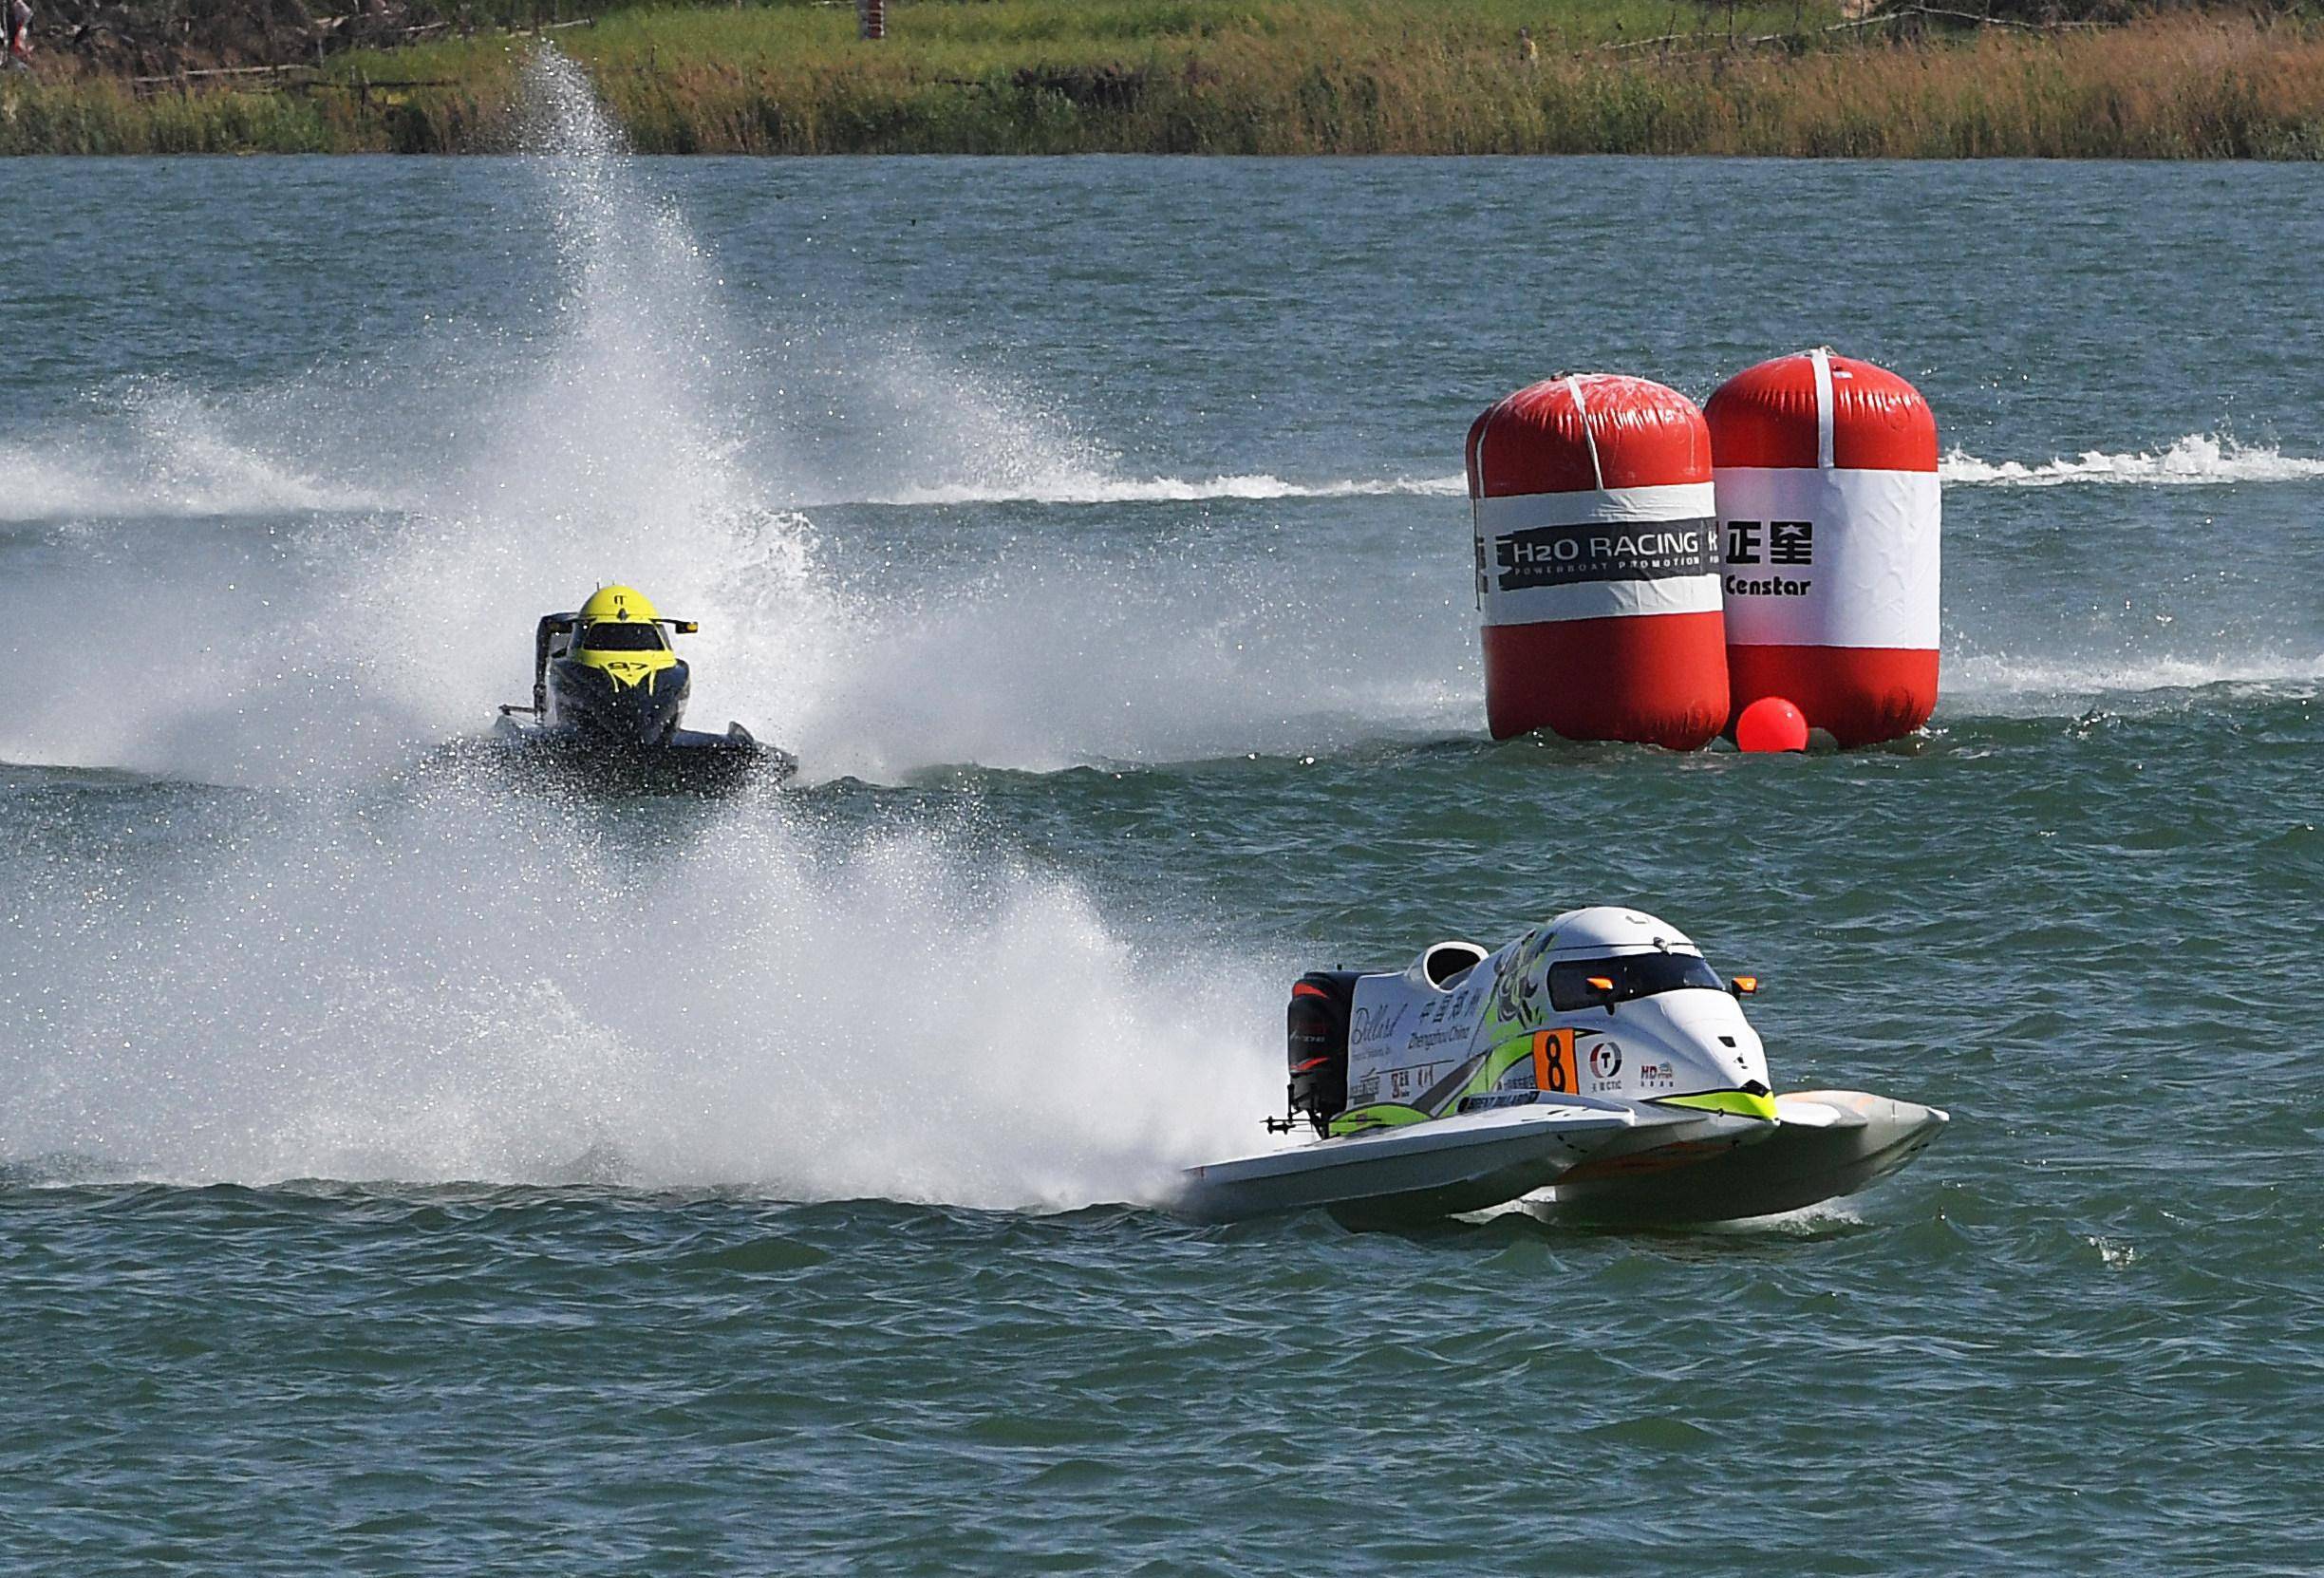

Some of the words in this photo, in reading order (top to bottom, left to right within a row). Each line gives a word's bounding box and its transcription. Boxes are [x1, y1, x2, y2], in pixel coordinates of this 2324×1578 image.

[1513, 537, 1580, 563] H2O
[1590, 532, 1699, 558] RACING
[1514, 562, 1609, 576] POWERBOAT
[1619, 555, 1700, 570] PROMOTION
[1725, 573, 1812, 596] Censtar
[1545, 1033, 1566, 1093] 8
[1640, 1065, 1658, 1080] HD
